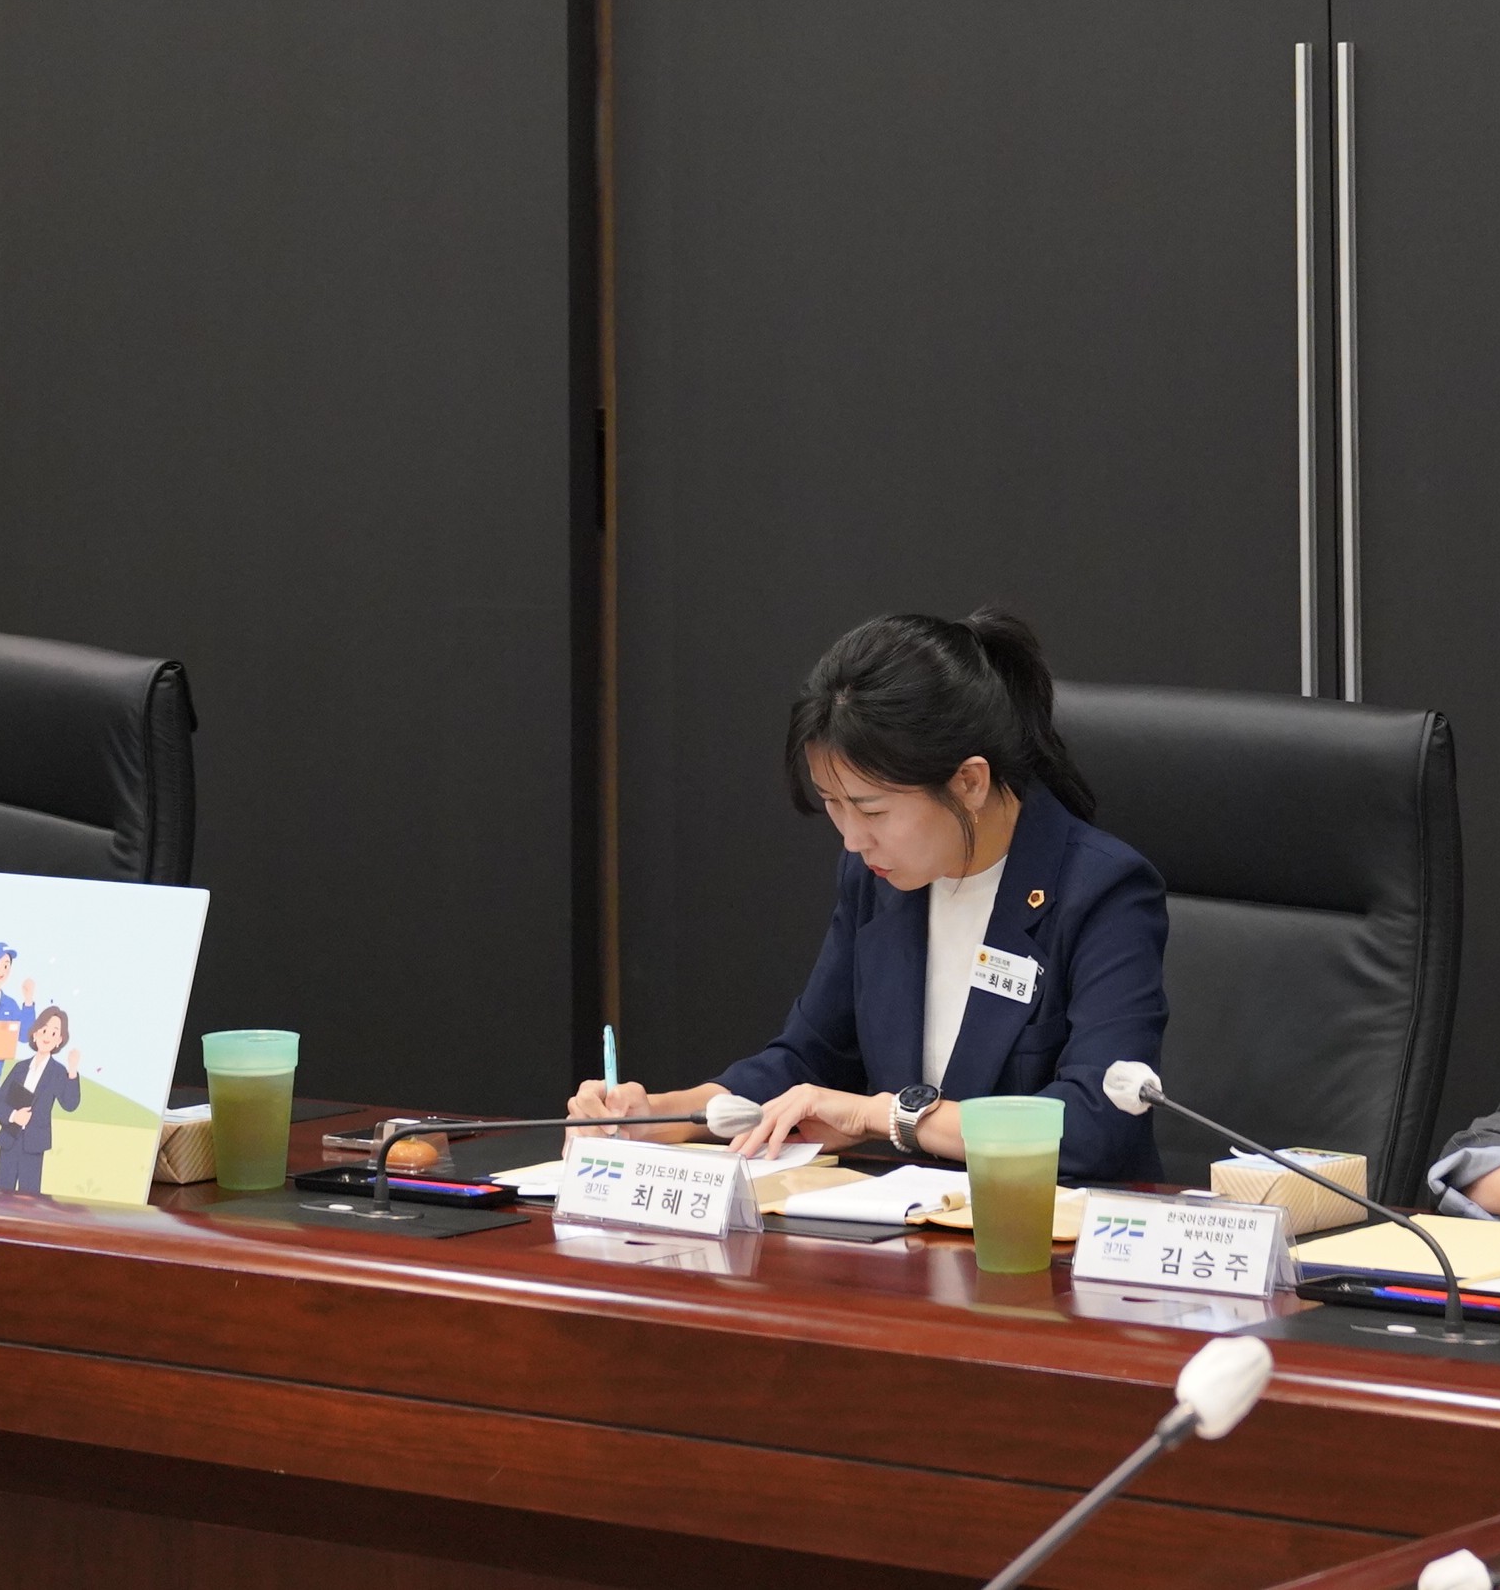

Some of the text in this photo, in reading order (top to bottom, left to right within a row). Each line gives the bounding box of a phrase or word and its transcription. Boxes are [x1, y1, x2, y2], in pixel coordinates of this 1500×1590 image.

[635, 1162, 725, 1188] 경기도의회 도의원
[584, 1181, 611, 1196] 경기도
[631, 1184, 711, 1219] 최혜경
[1103, 1241, 1132, 1257] 경기도
[1160, 1246, 1249, 1282] 김승주
